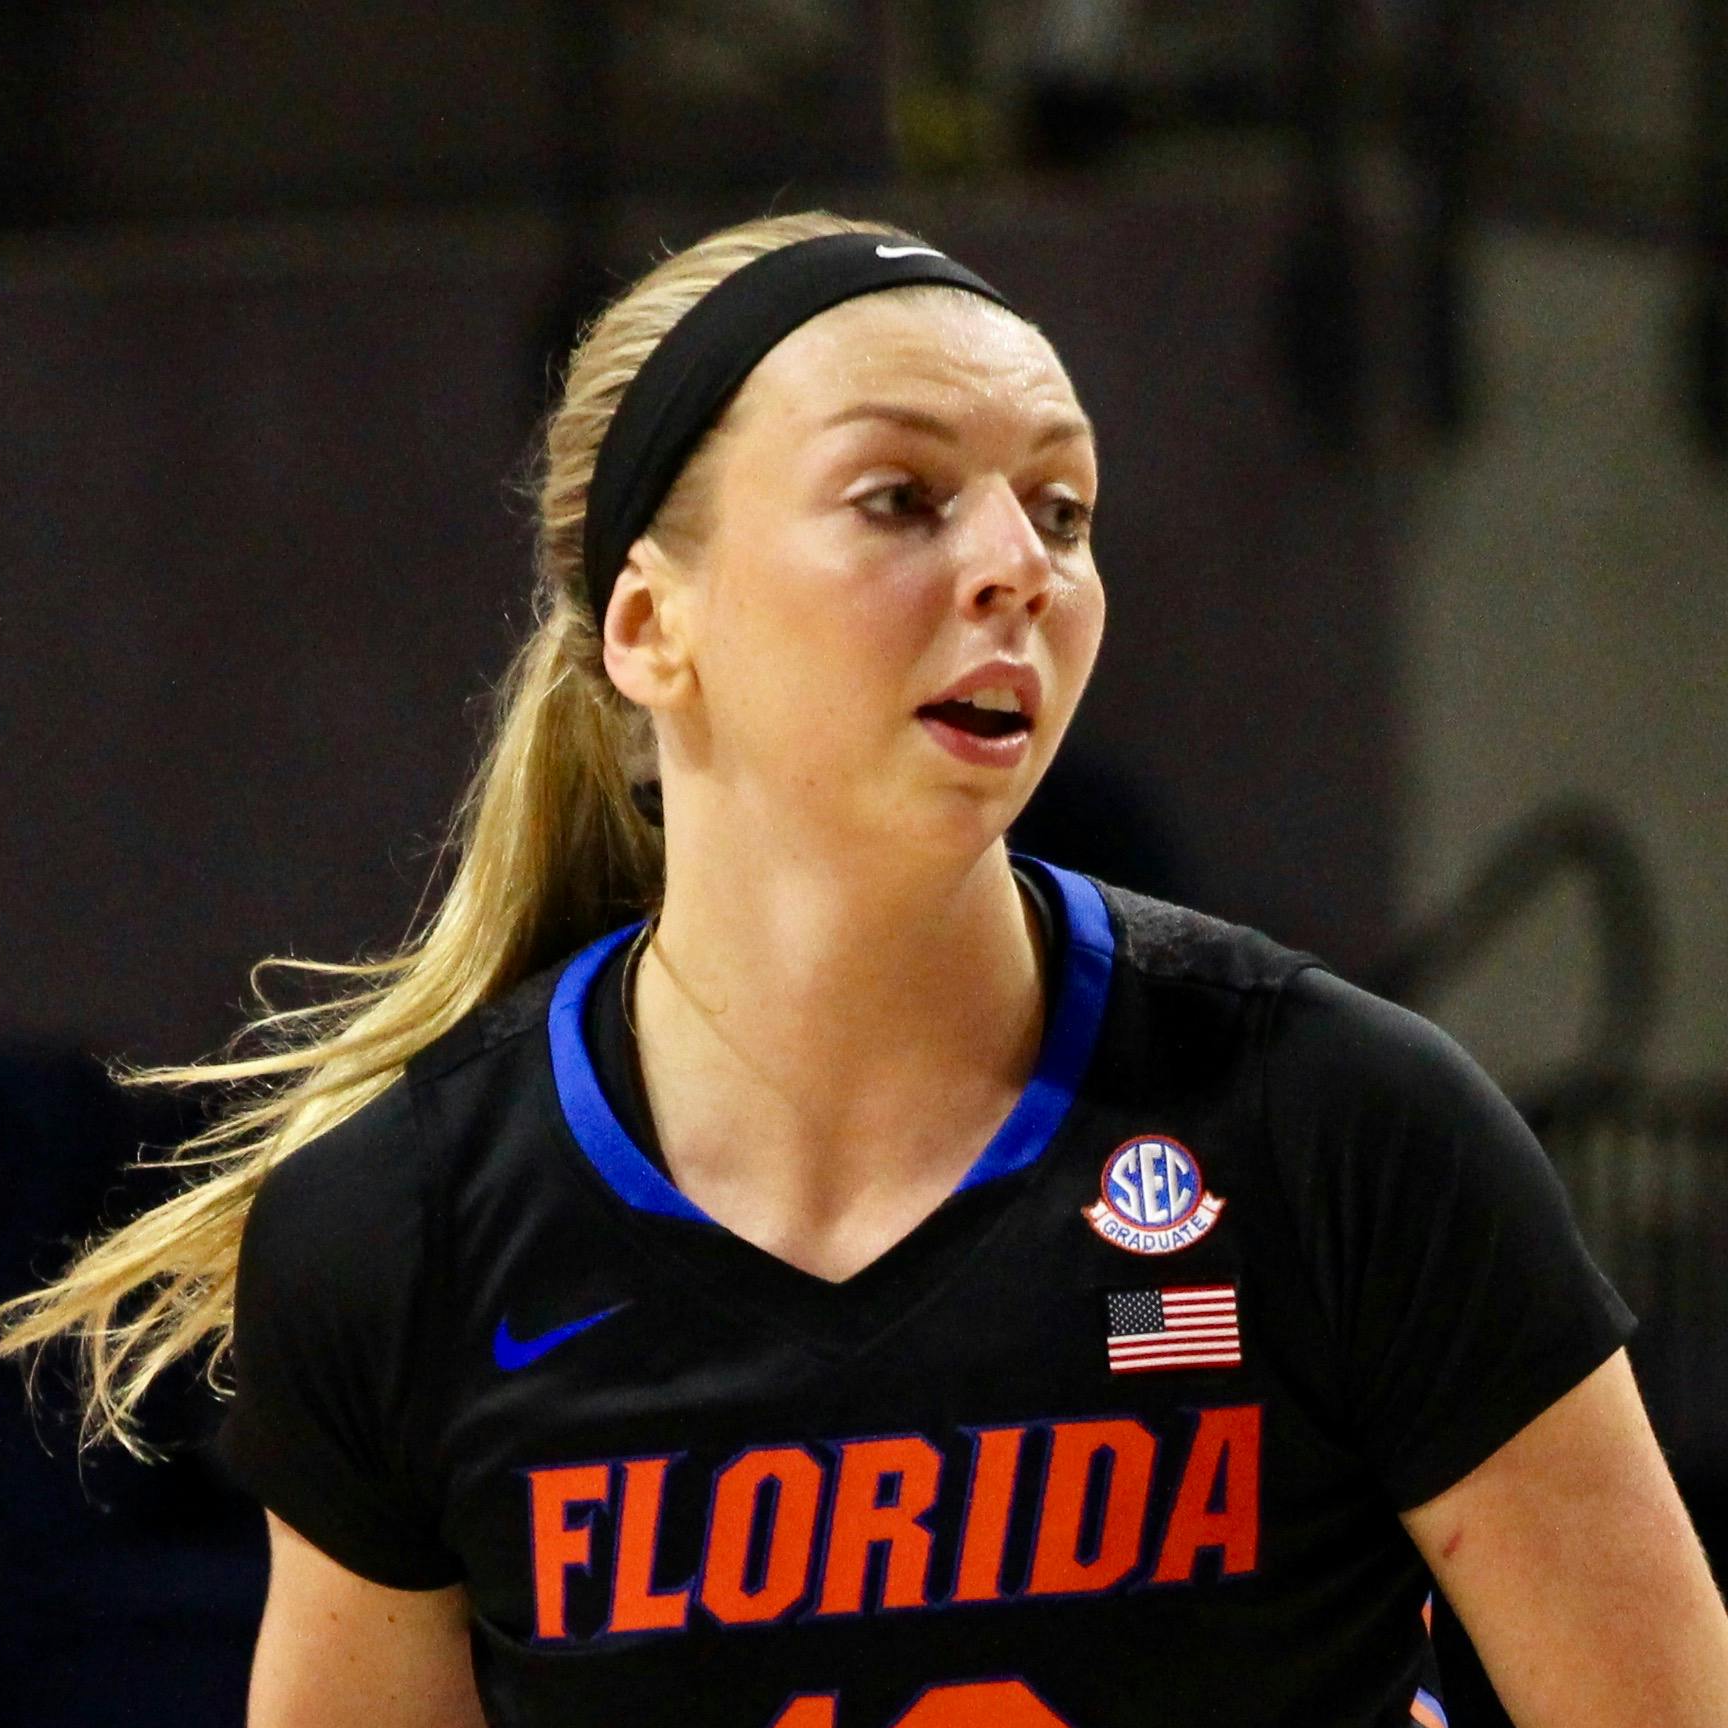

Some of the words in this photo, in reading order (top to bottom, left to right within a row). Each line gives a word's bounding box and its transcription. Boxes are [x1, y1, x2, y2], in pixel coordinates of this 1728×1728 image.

[1110, 1142, 1192, 1224] SEC
[1103, 1214, 1208, 1250] GRADUATE
[520, 1402, 1267, 1646] FLORIDA
